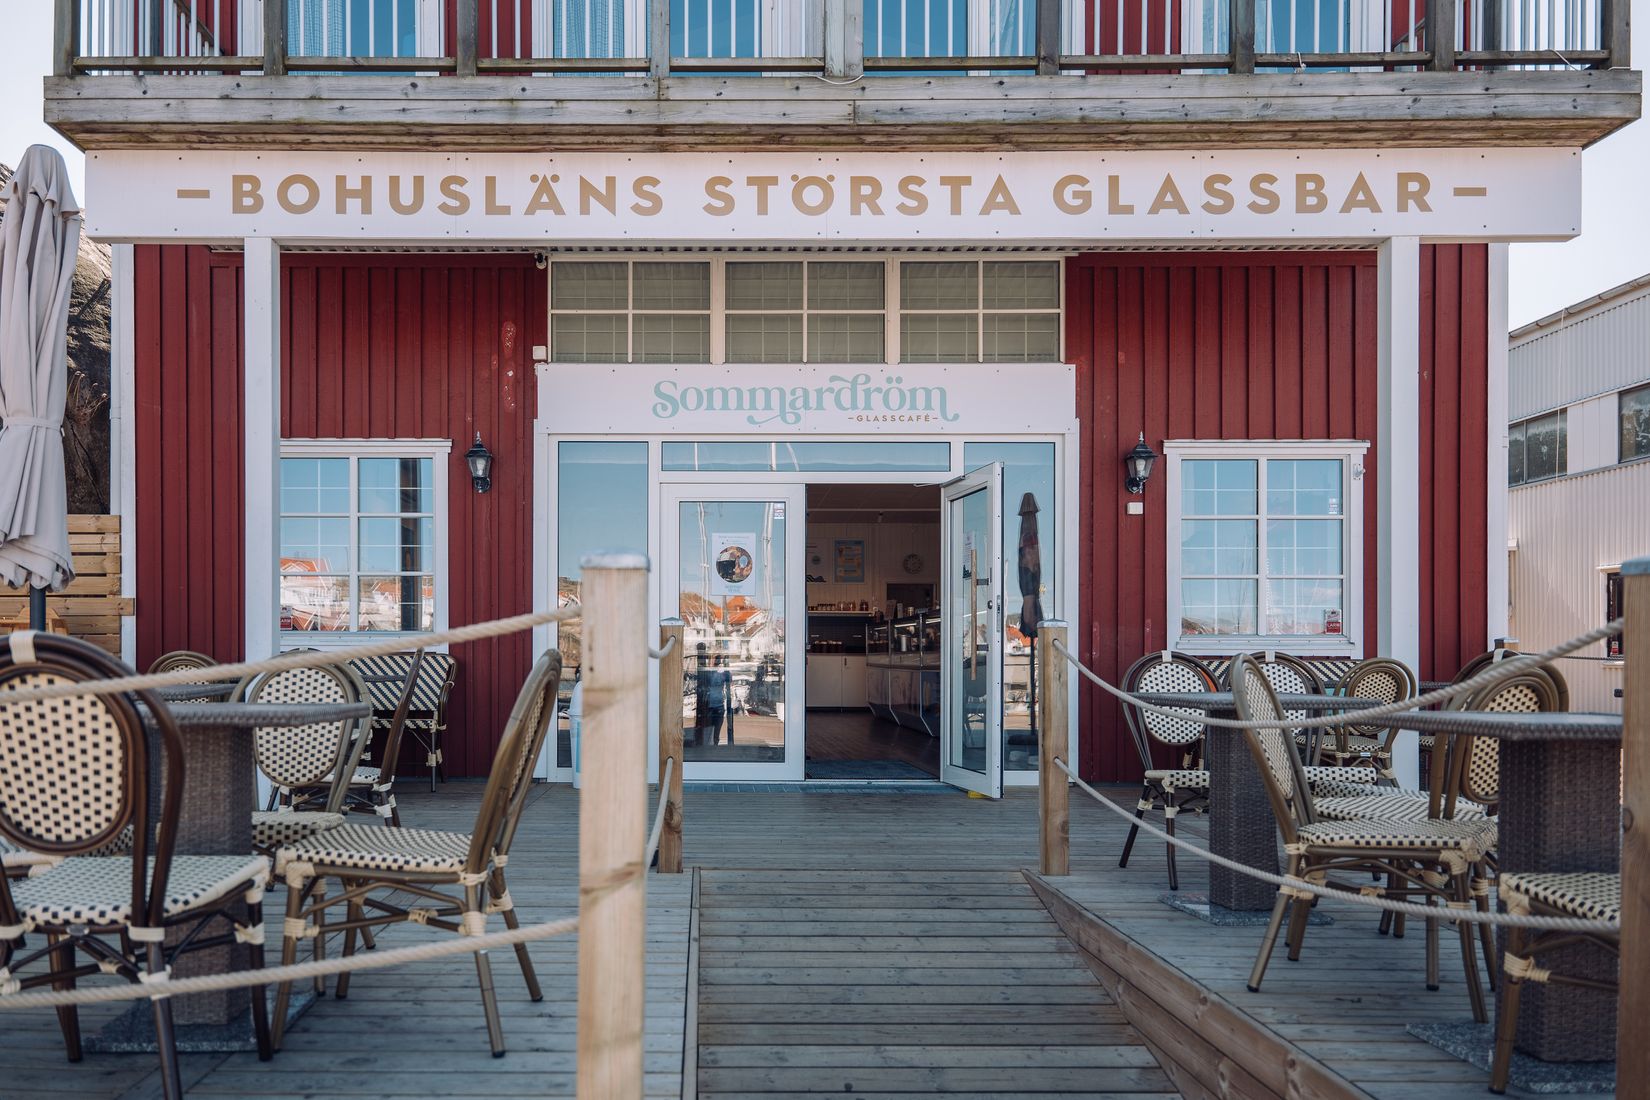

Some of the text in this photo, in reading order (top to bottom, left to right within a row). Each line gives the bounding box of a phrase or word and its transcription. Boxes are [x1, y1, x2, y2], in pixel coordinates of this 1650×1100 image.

[231, 171, 1431, 215] BOHUSLÄNS STÖRSTA GLASSBAR
[651, 374, 960, 425] Sommardröm
[856, 413, 930, 423] GLASSCAFÉ
